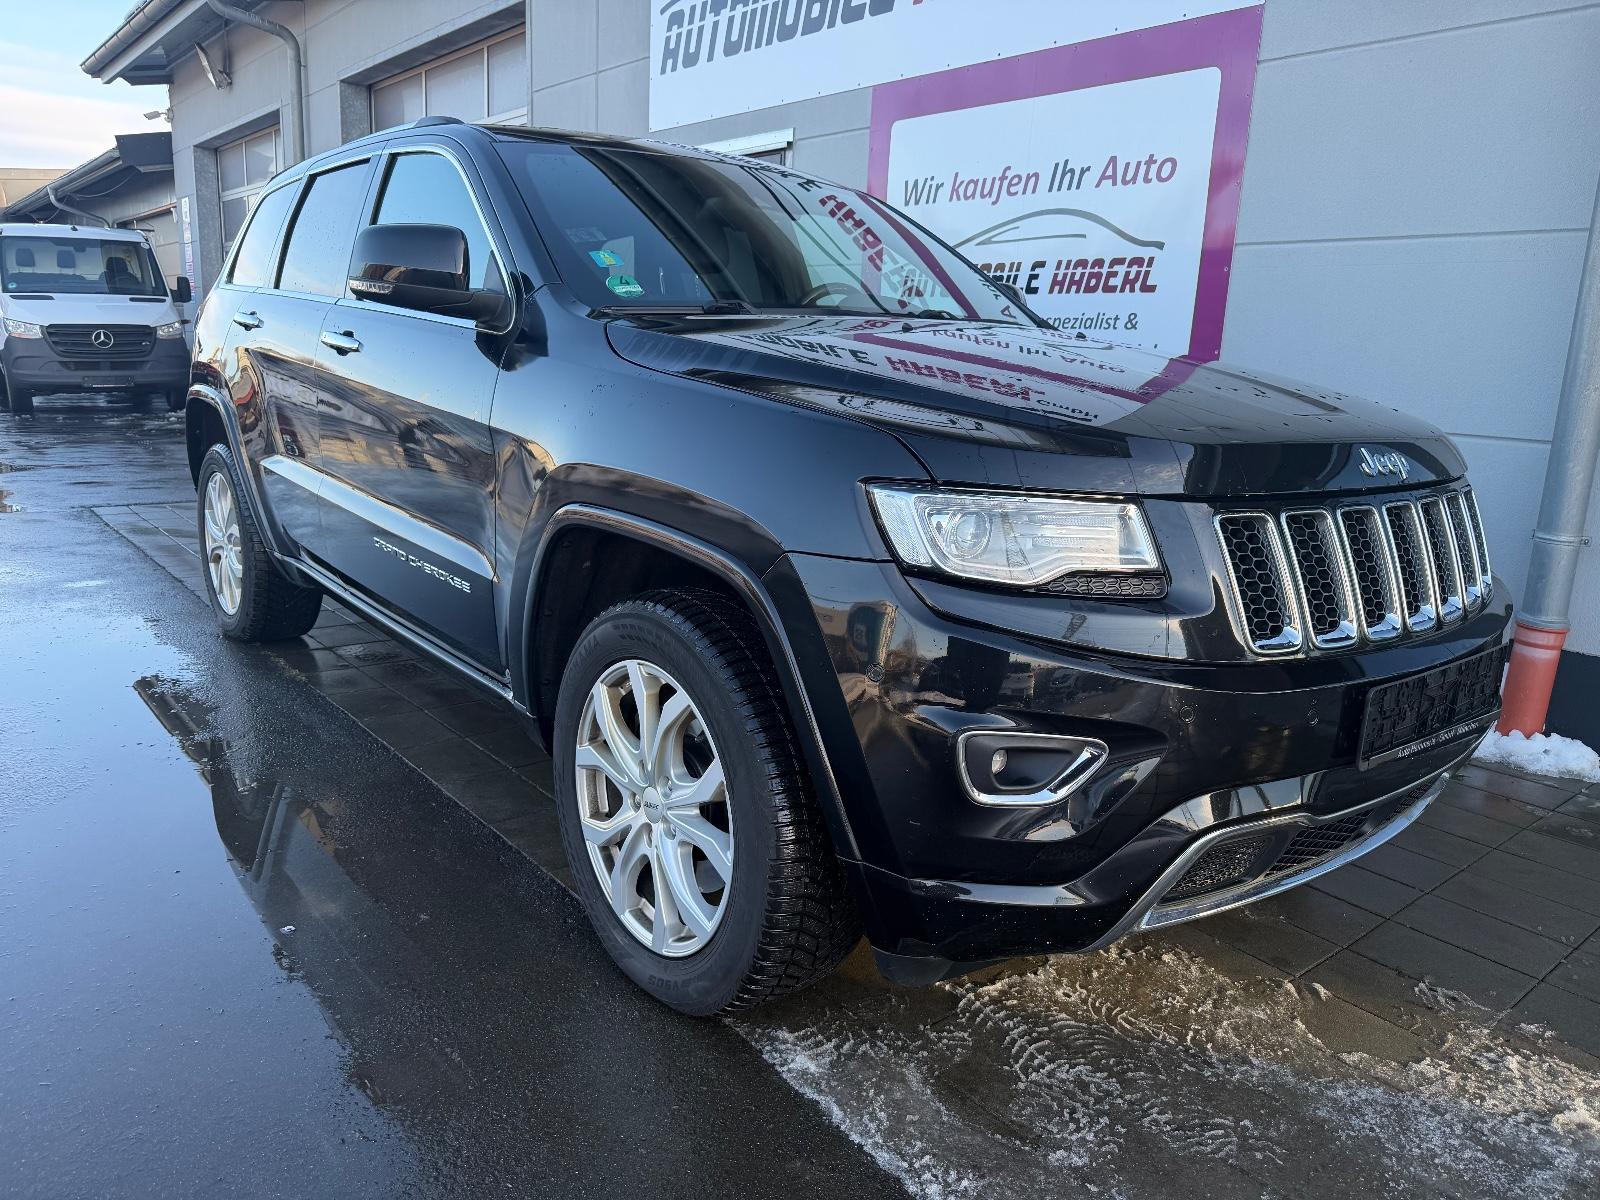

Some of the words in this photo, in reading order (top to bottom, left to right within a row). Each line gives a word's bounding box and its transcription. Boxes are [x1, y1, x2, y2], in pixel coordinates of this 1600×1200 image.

[659, 0, 895, 76] AUTOMOB
[904, 176, 944, 207] Wir
[948, 165, 1040, 206] kaufen
[1047, 159, 1091, 192] Ihr
[1095, 154, 1178, 188] Auto
[1048, 256, 1158, 295] HABERL
[1124, 312, 1138, 330] &
[1359, 447, 1410, 480] Jeep
